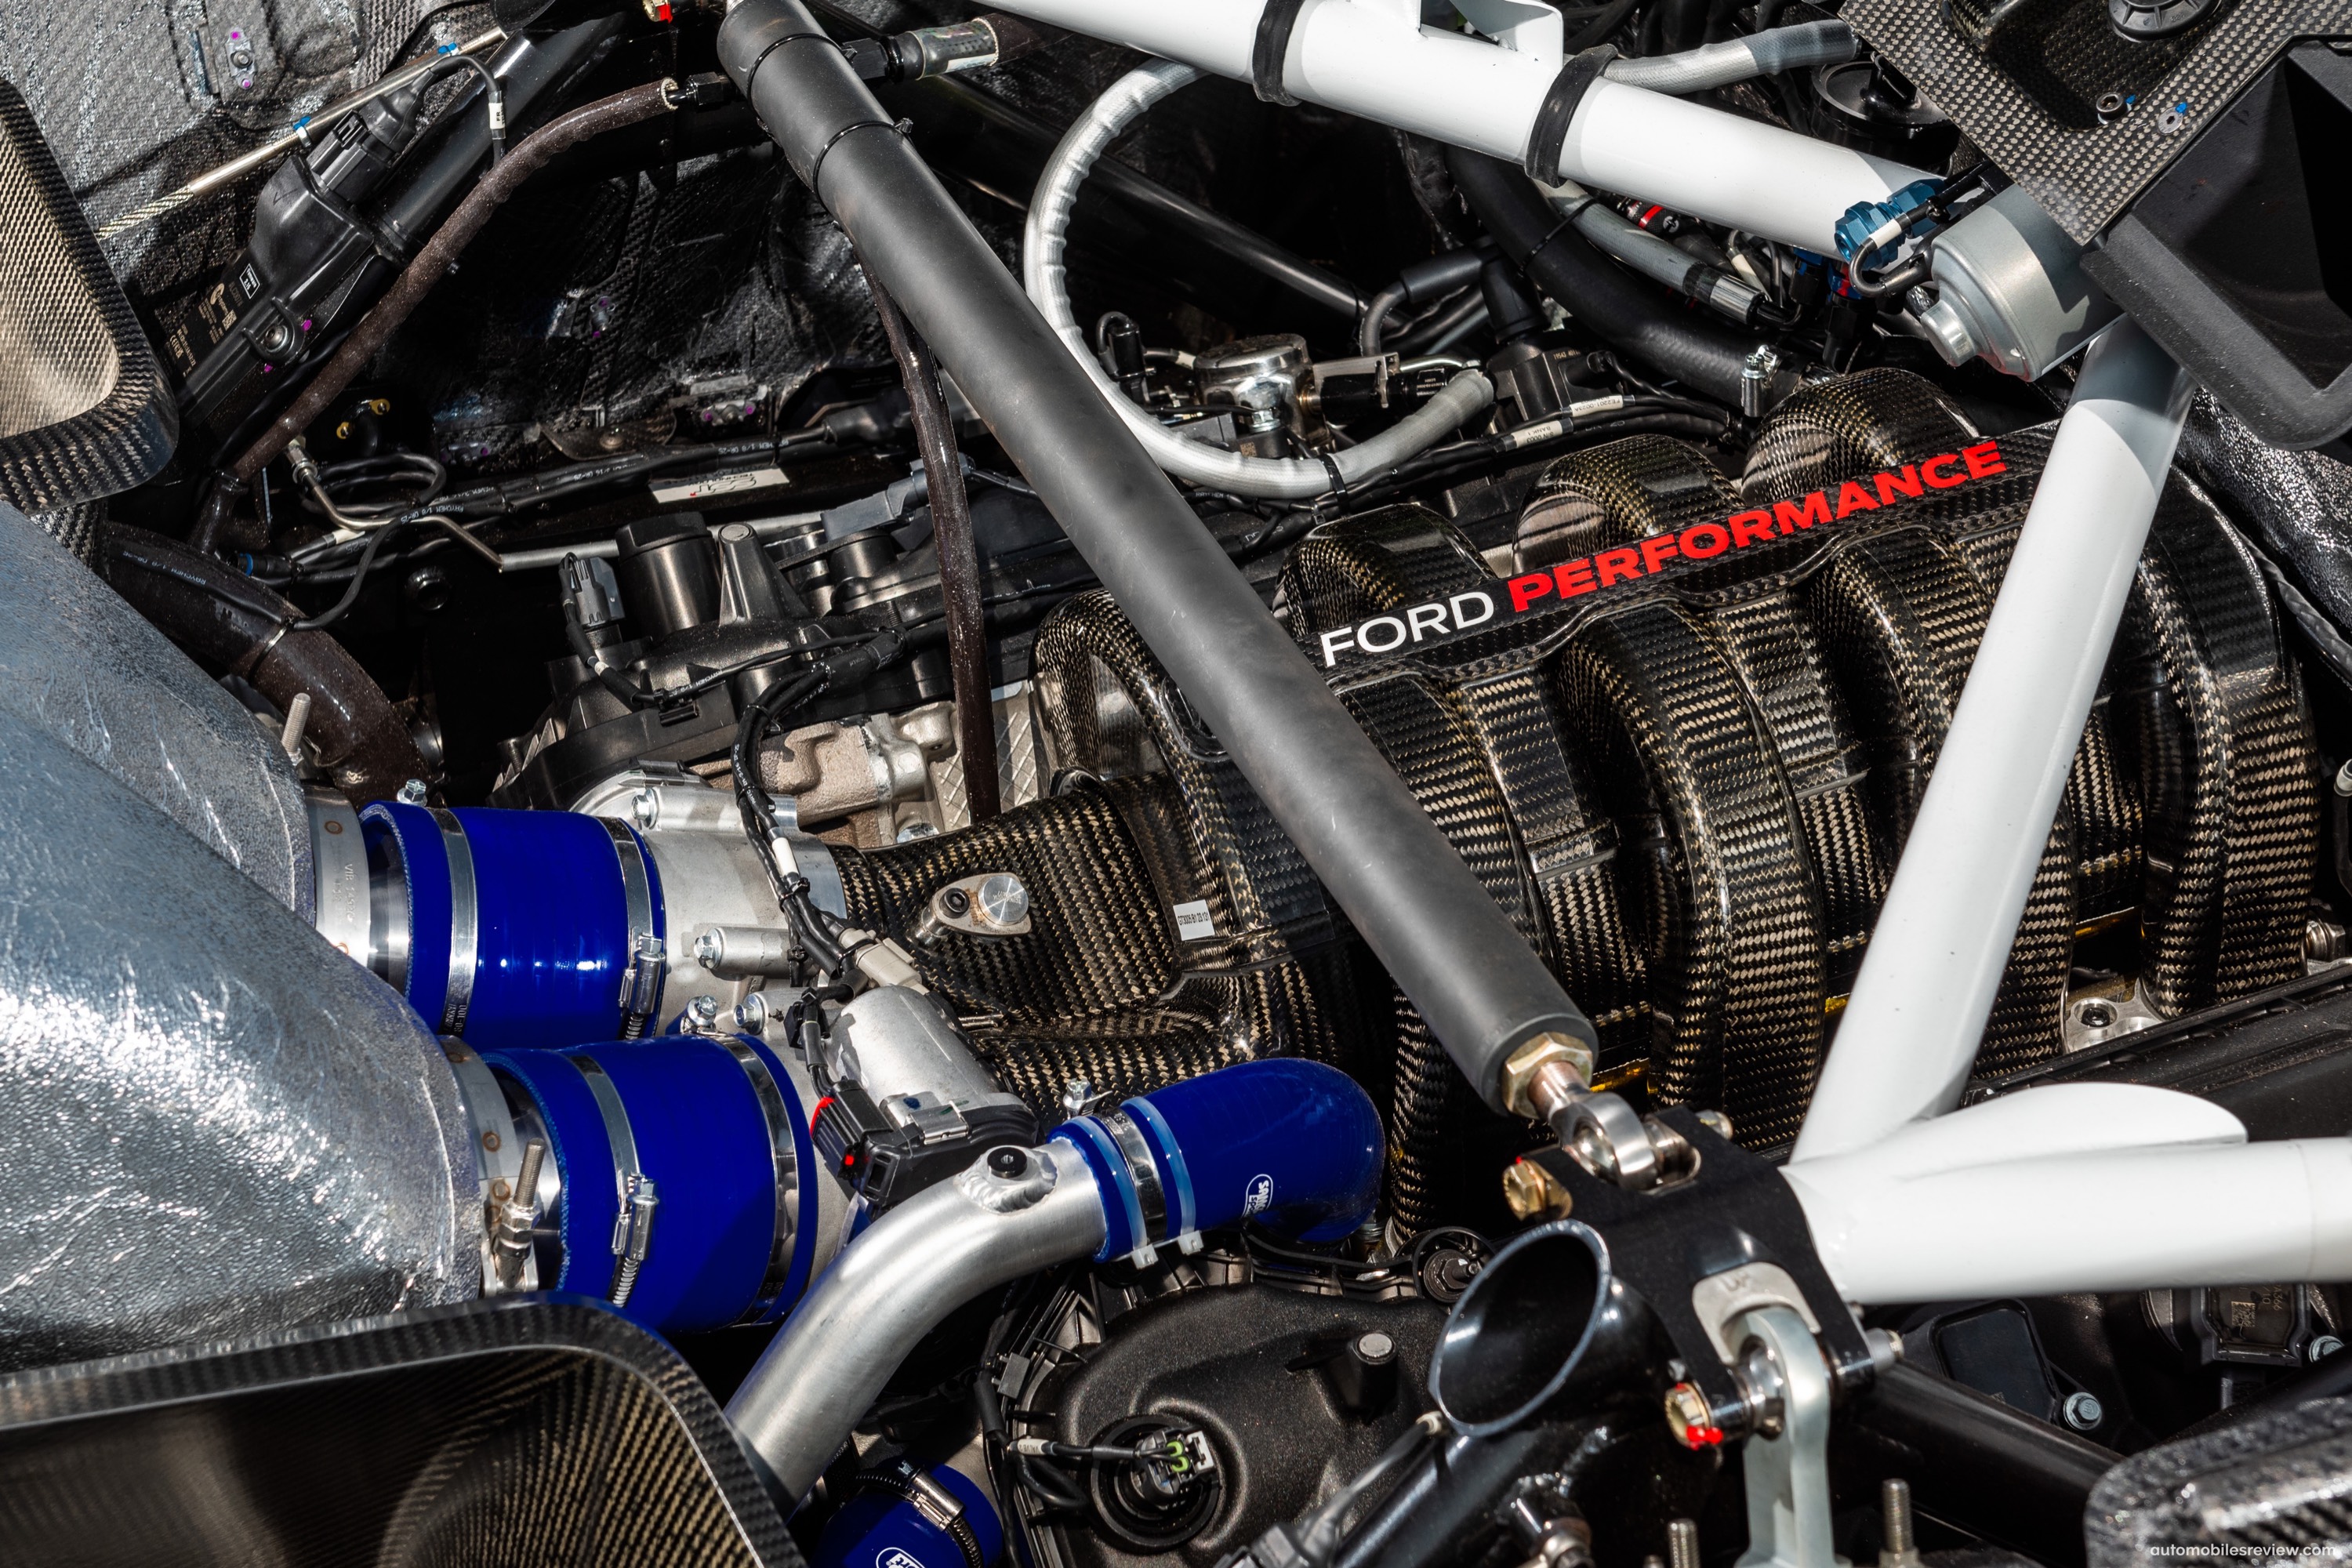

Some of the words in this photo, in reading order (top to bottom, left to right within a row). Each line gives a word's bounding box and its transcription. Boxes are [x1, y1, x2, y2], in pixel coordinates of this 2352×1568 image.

[170, 567, 206, 586] RAYCHEM
[1320, 589, 1495, 668] FORD
[1508, 440, 2008, 613] PERFORMANCE
